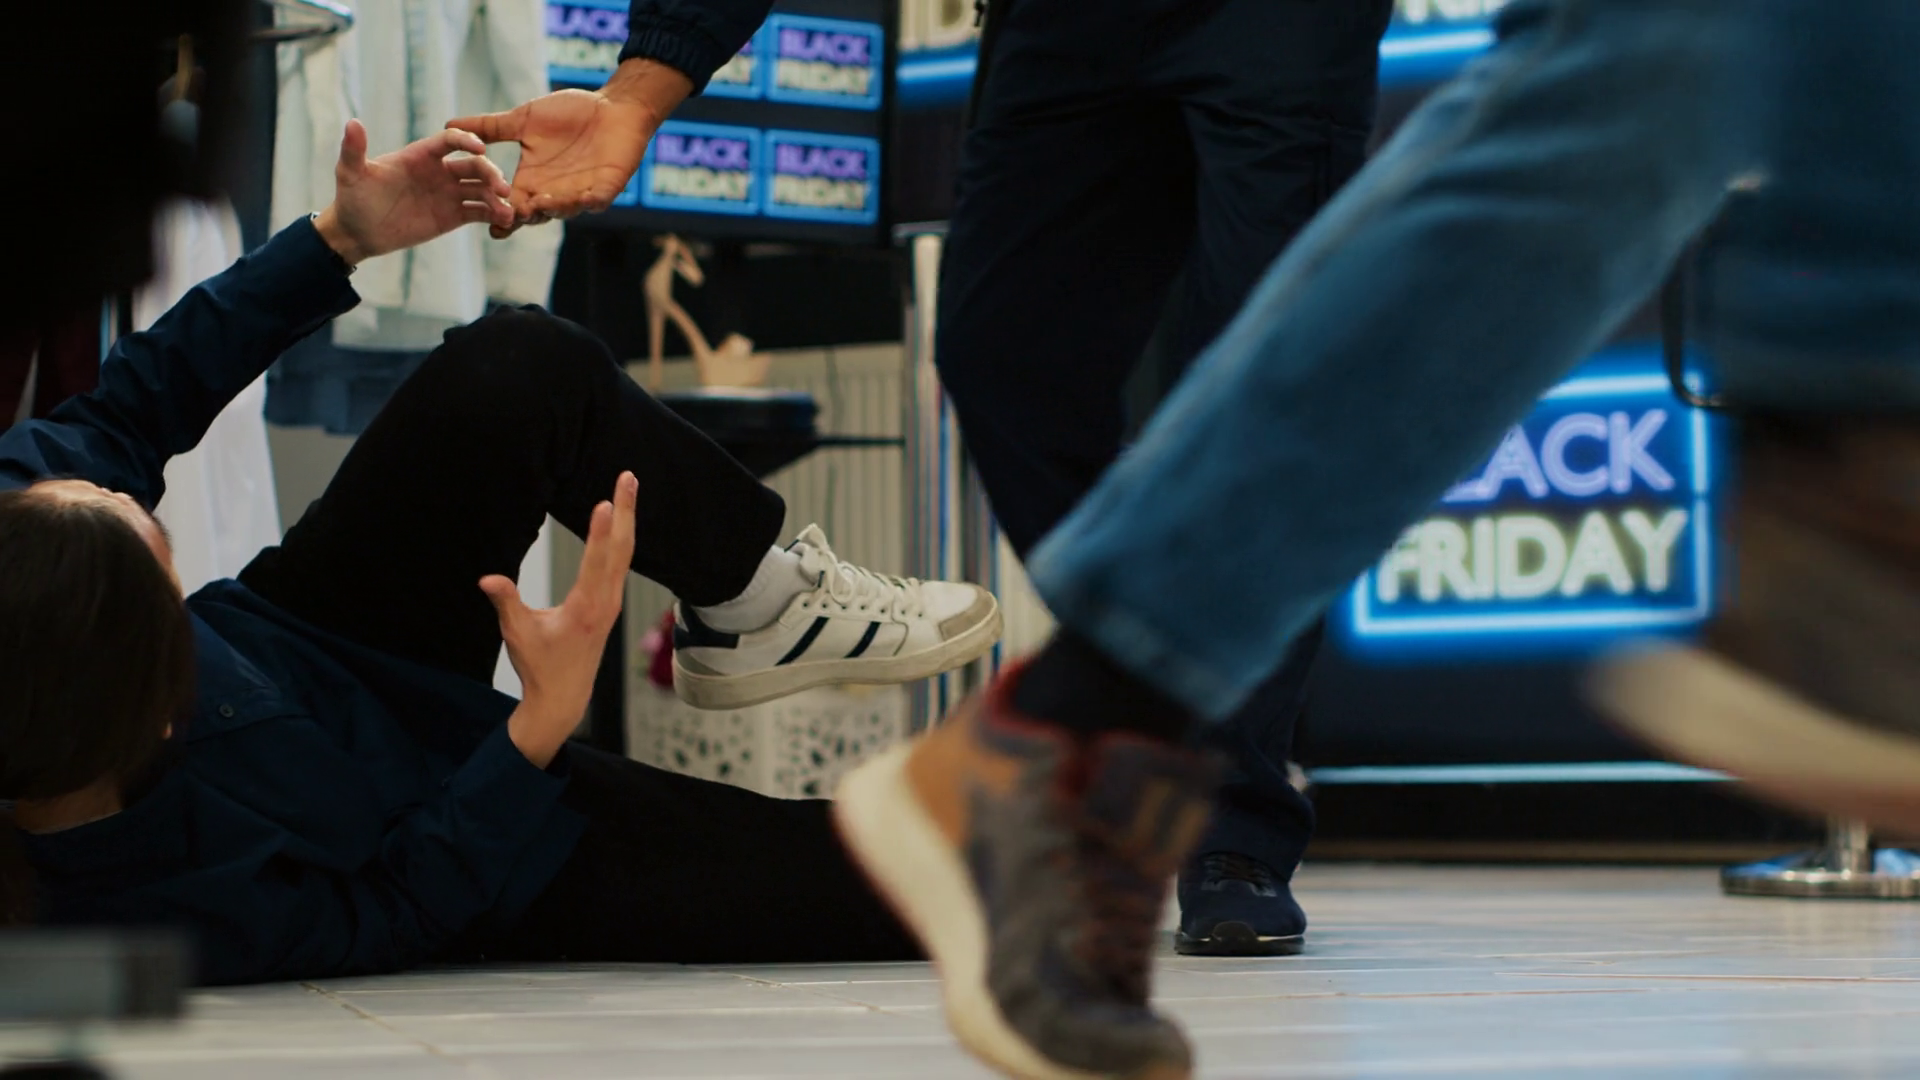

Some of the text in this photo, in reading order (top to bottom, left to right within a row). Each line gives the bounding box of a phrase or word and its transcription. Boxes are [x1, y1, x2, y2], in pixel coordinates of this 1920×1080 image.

[547, 6, 630, 42] LACK
[778, 27, 871, 65] BLACK
[777, 58, 876, 96] FRIDAY
[656, 132, 749, 171] BLACK
[775, 142, 868, 179] BLACK
[653, 164, 753, 201] FRIDAY
[773, 173, 870, 210] FRIDAY
[1443, 408, 1675, 500] ACK
[1376, 510, 1688, 602] FRIDAY
